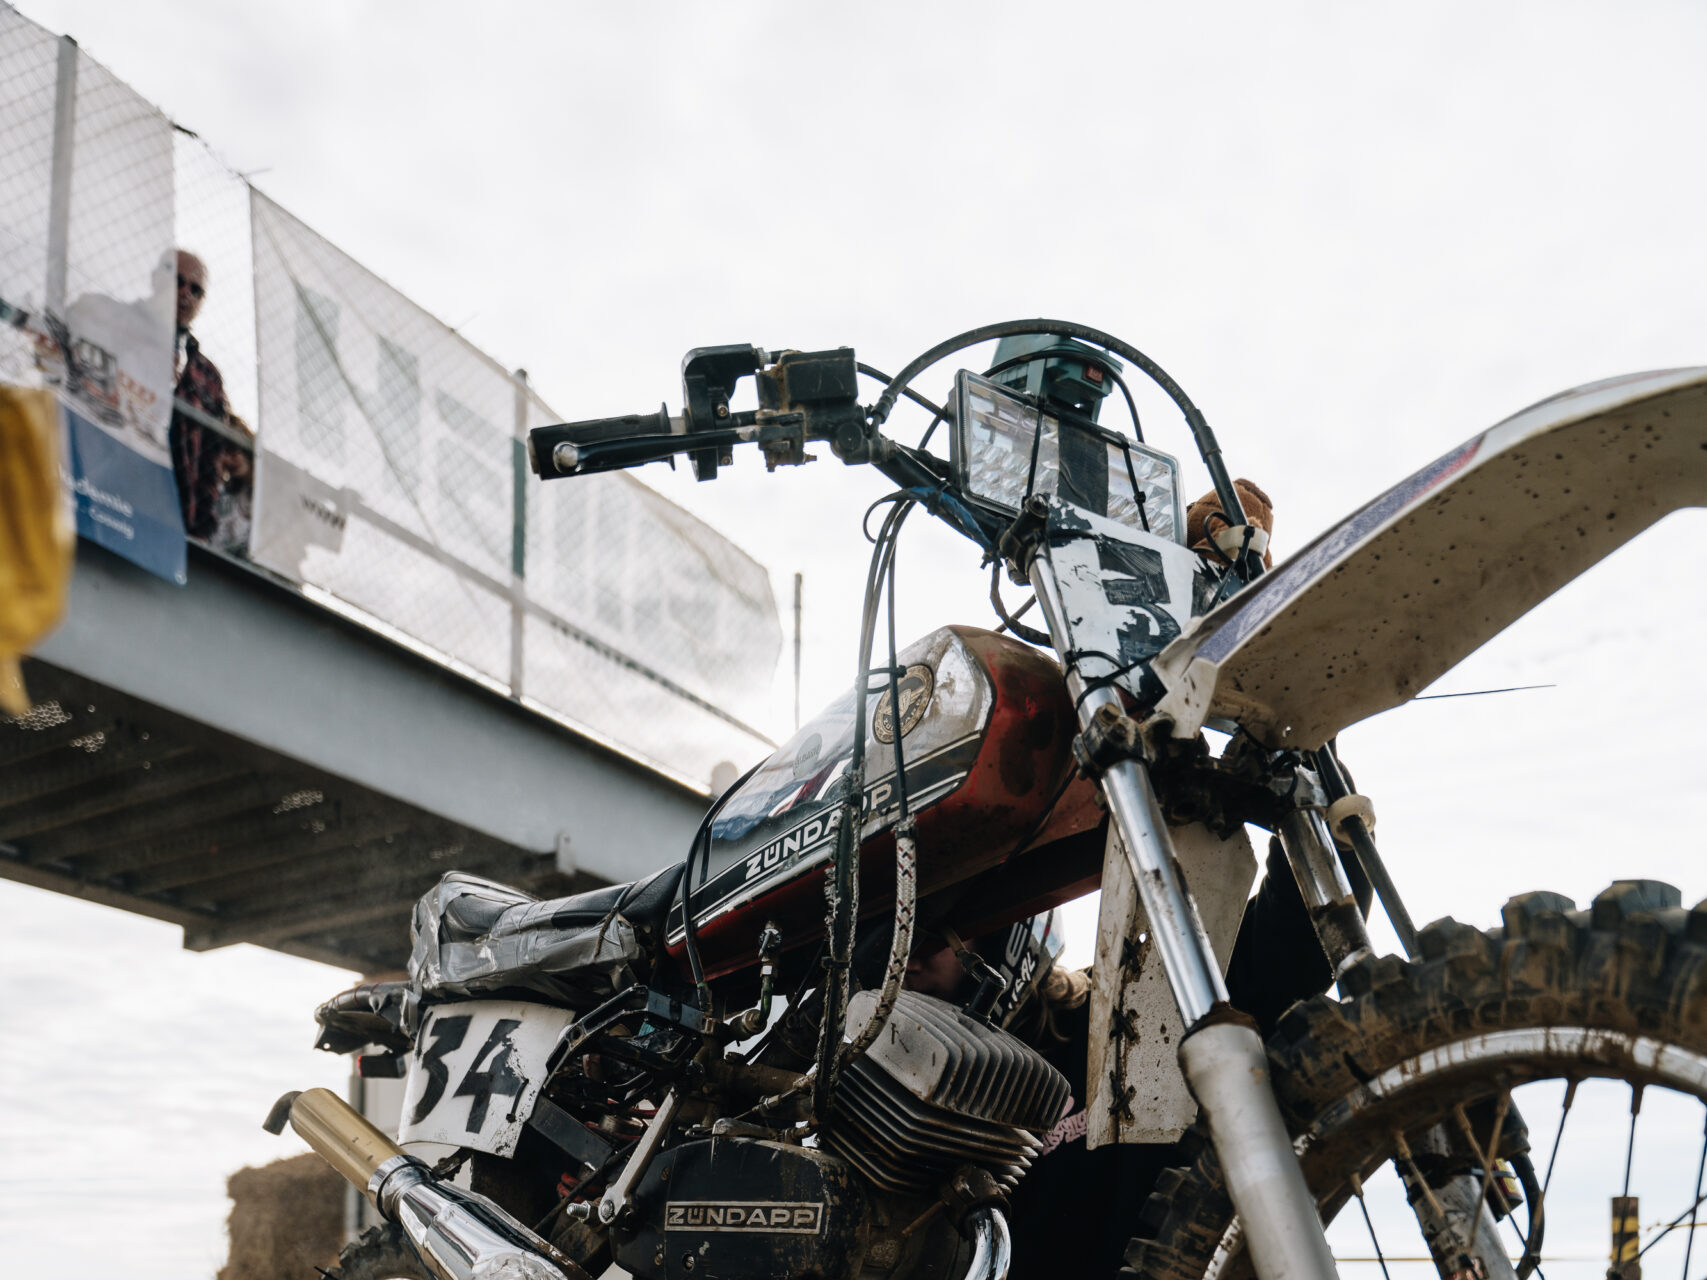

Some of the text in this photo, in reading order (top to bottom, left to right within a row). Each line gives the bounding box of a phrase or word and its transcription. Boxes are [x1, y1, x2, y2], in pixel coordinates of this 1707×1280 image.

[745, 782, 892, 880] ZÜNDAP
[410, 1013, 522, 1135] 34
[667, 1207, 816, 1227] ZÜNDAPP
